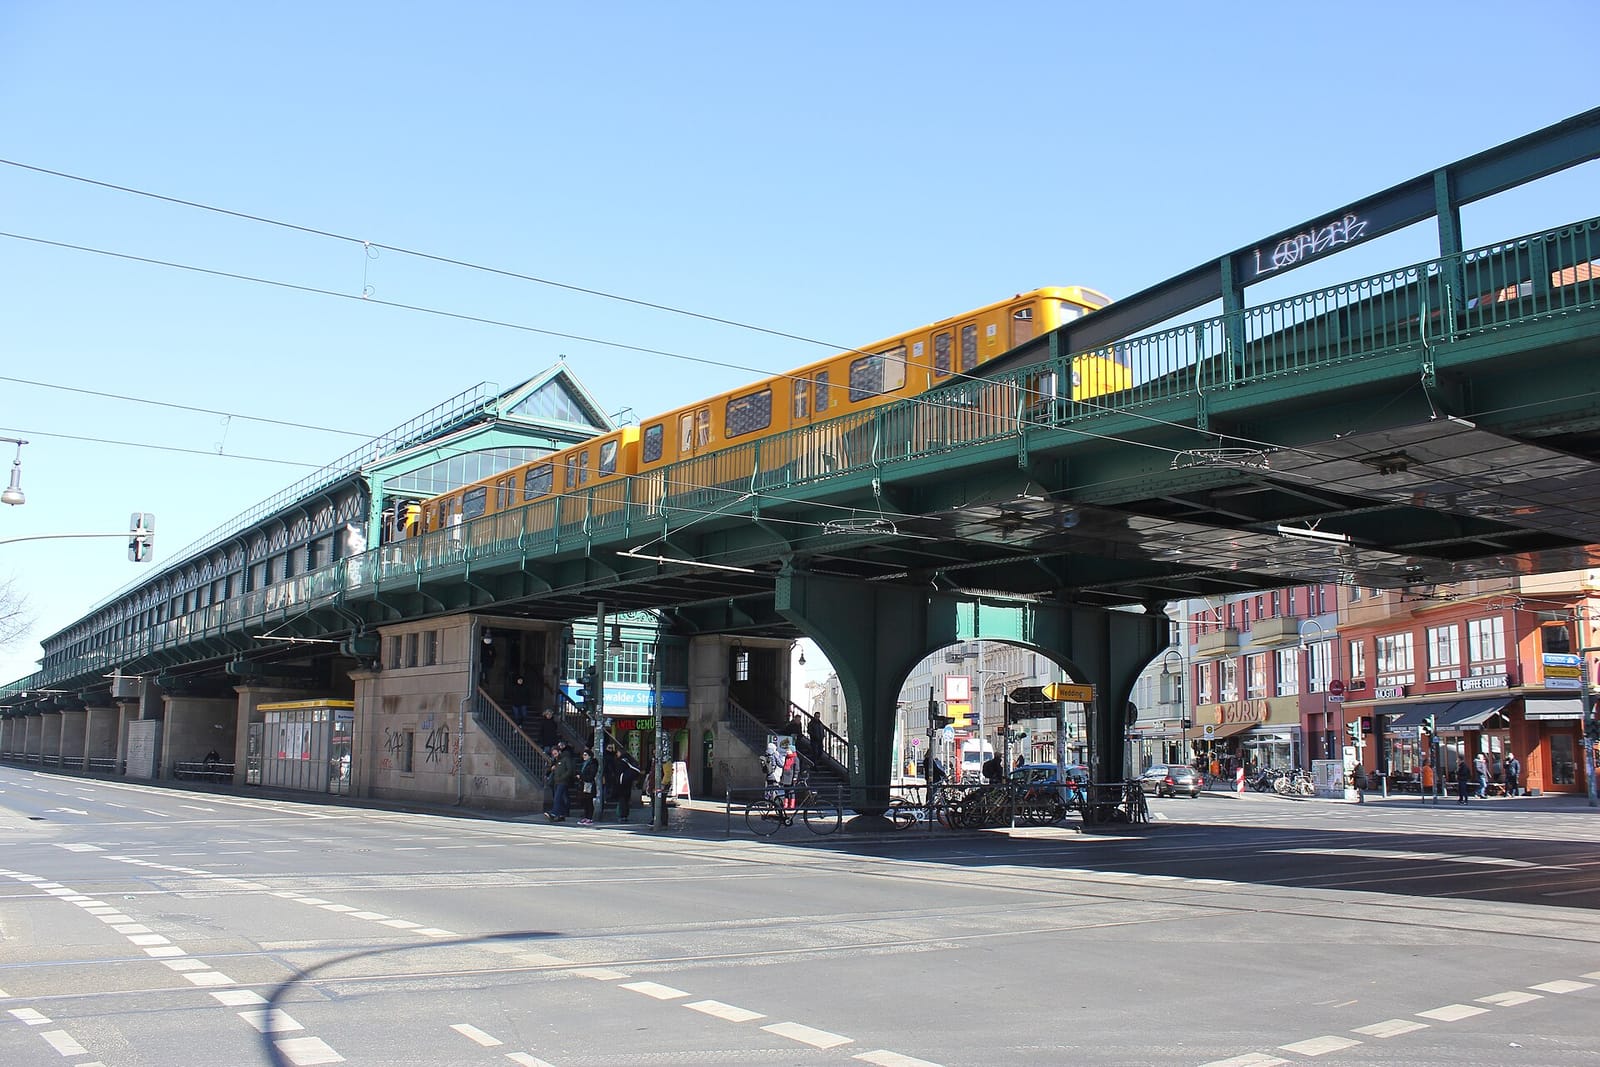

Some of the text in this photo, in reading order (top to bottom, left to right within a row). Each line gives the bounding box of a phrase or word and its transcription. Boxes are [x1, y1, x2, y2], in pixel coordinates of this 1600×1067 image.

[1060, 689, 1085, 699] Wedding
[1226, 699, 1260, 722] GURU
[636, 717, 655, 730] GEMÜ
